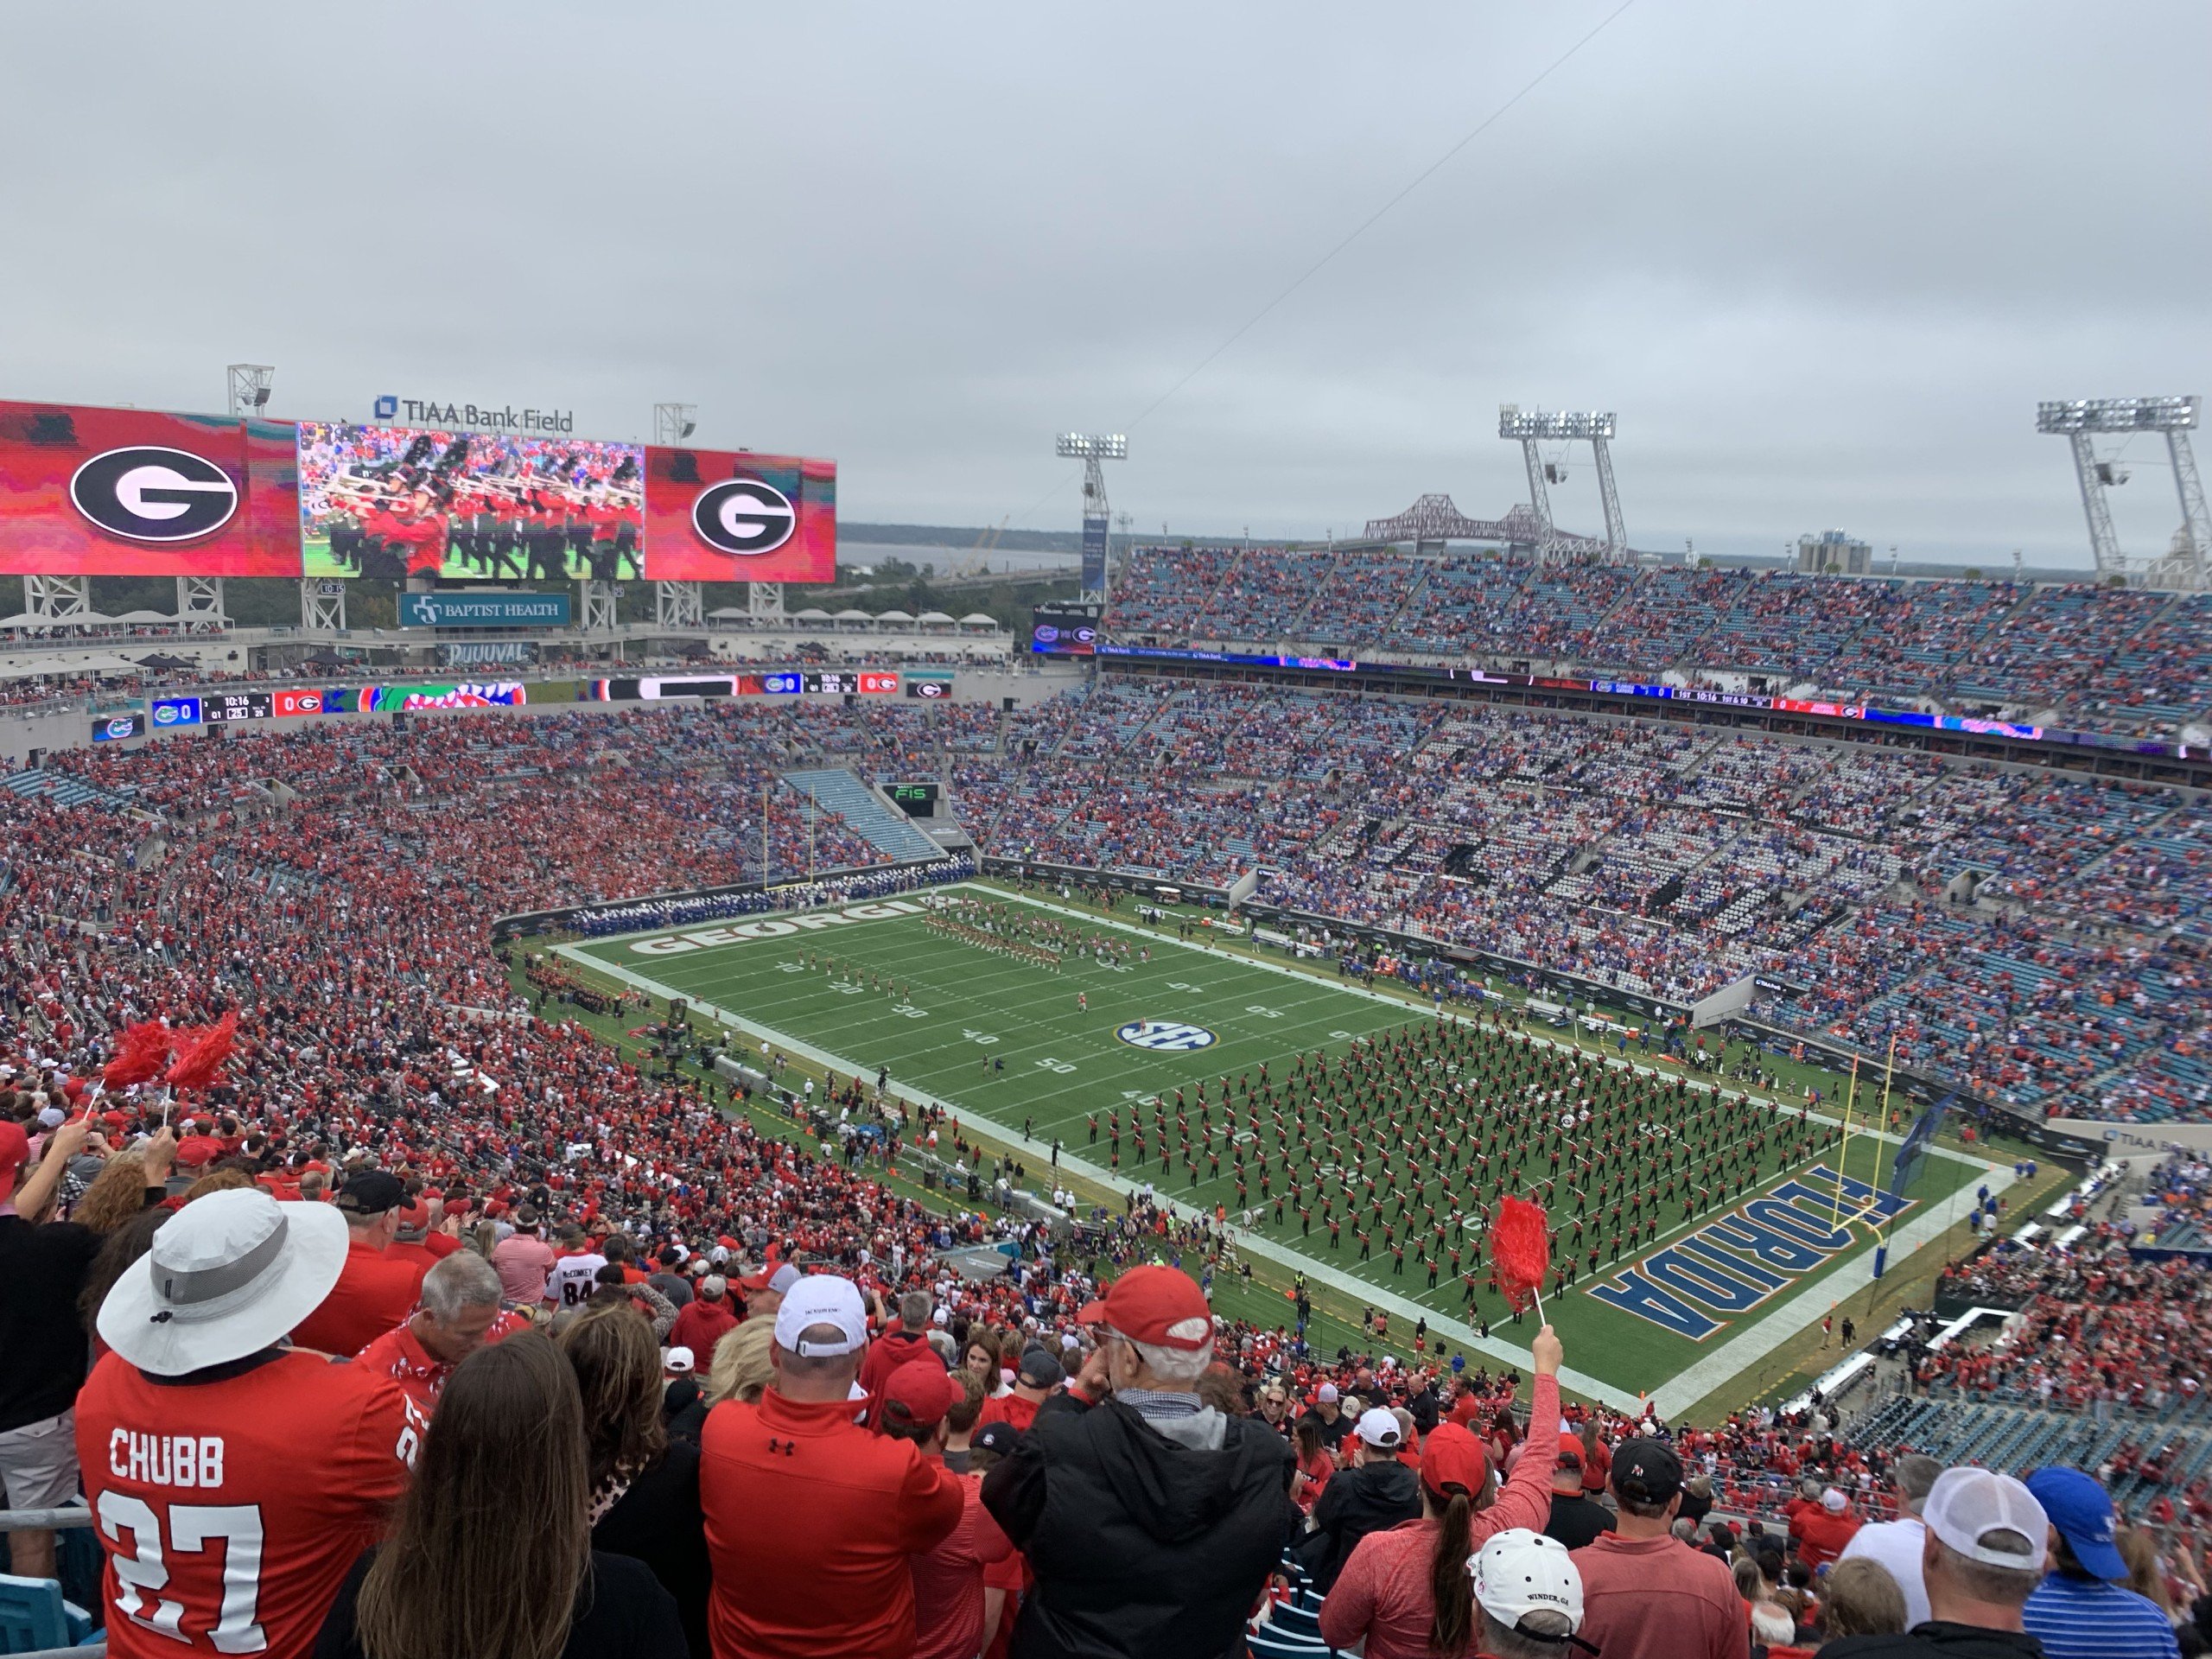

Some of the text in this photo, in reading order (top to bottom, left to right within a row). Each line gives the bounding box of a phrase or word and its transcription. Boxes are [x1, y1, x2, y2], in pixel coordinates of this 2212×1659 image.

[403, 400, 573, 432] TIAA Bank Field
[445, 605, 558, 617] BAPTIST HEALTH
[785, 677, 795, 690] 0
[867, 677, 876, 689] 0
[1659, 688, 1664, 696] 0
[1697, 692, 1717, 702] 10:16
[226, 696, 249, 707] 10:16
[285, 697, 294, 710] 0
[1779, 700, 1786, 709] 0
[181, 704, 190, 719] 0
[895, 789, 926, 798] FIS
[629, 896, 974, 955] GEORGIA
[775, 961, 804, 972] 10
[829, 982, 864, 994] 20
[891, 1004, 929, 1018] 30
[1245, 1006, 1284, 1018] 50
[962, 1028, 1000, 1045] 40
[1122, 1021, 1211, 1050] SEC
[1034, 1057, 1077, 1073] 50
[2120, 1133, 2156, 1150] TIAA
[1584, 1163, 1922, 1343] FLORIDA
[563, 1281, 593, 1306] 84
[110, 1427, 224, 1488] CHUBB
[97, 1490, 268, 1654] 27
[1527, 1593, 1569, 1606] WINDER, GA
